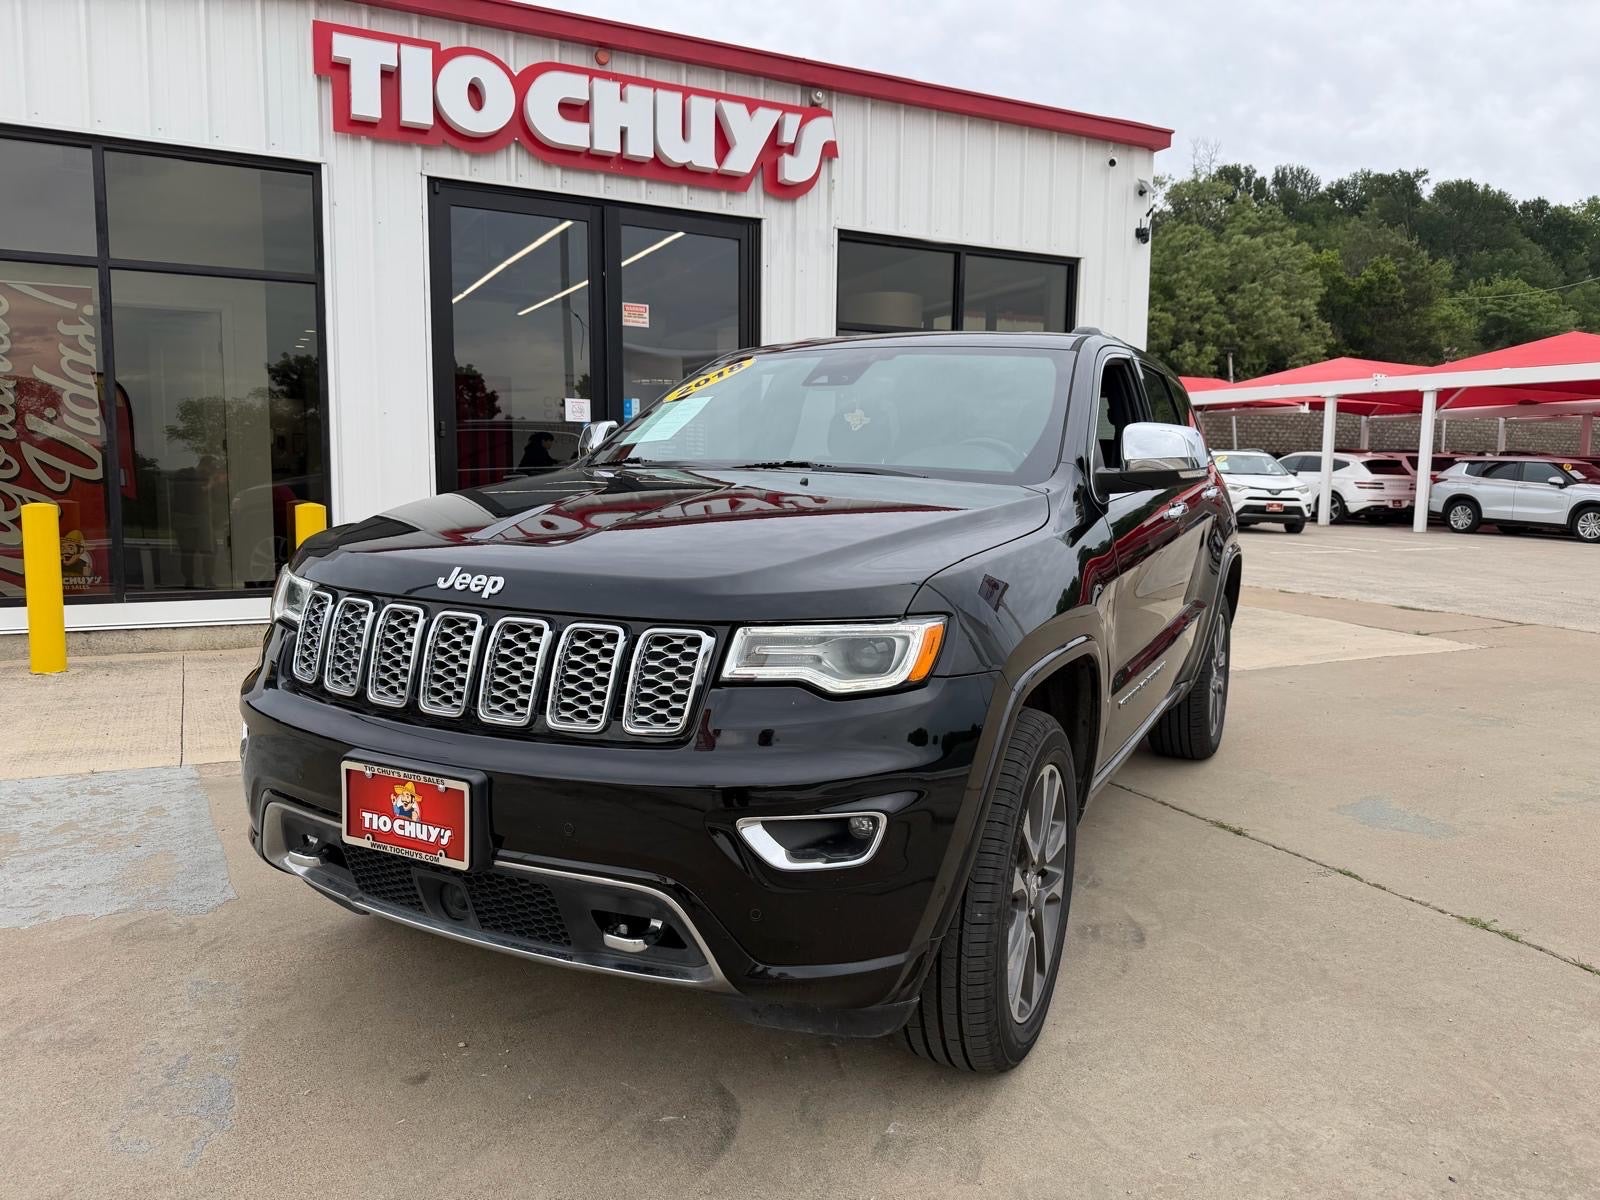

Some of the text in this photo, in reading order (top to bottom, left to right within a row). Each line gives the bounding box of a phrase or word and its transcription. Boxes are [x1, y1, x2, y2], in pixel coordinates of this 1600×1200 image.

[332, 31, 837, 186] TIO CHUY'S
[437, 566, 505, 599] Jeep
[364, 765, 445, 786] TIO CHUY'S AUTO SALES
[361, 811, 452, 846] TIO CHUY'S
[370, 842, 440, 863] WWW.TIOCHUYS.COM
